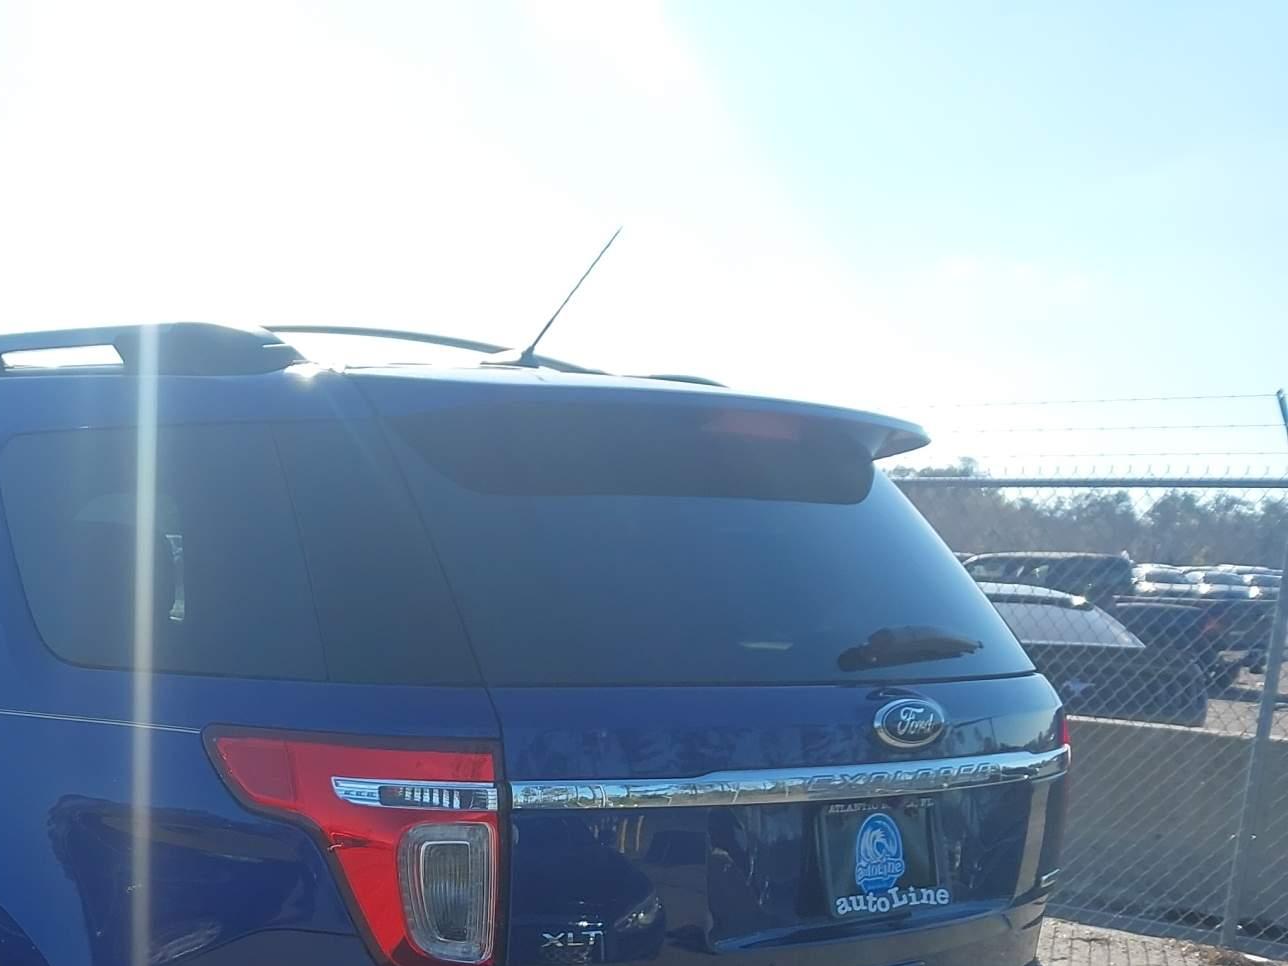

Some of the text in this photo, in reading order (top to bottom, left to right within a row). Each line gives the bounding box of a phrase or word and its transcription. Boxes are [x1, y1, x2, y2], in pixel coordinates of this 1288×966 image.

[897, 706, 936, 735] Ford
[835, 886, 949, 914] autoLine
[541, 931, 602, 947] XLT
